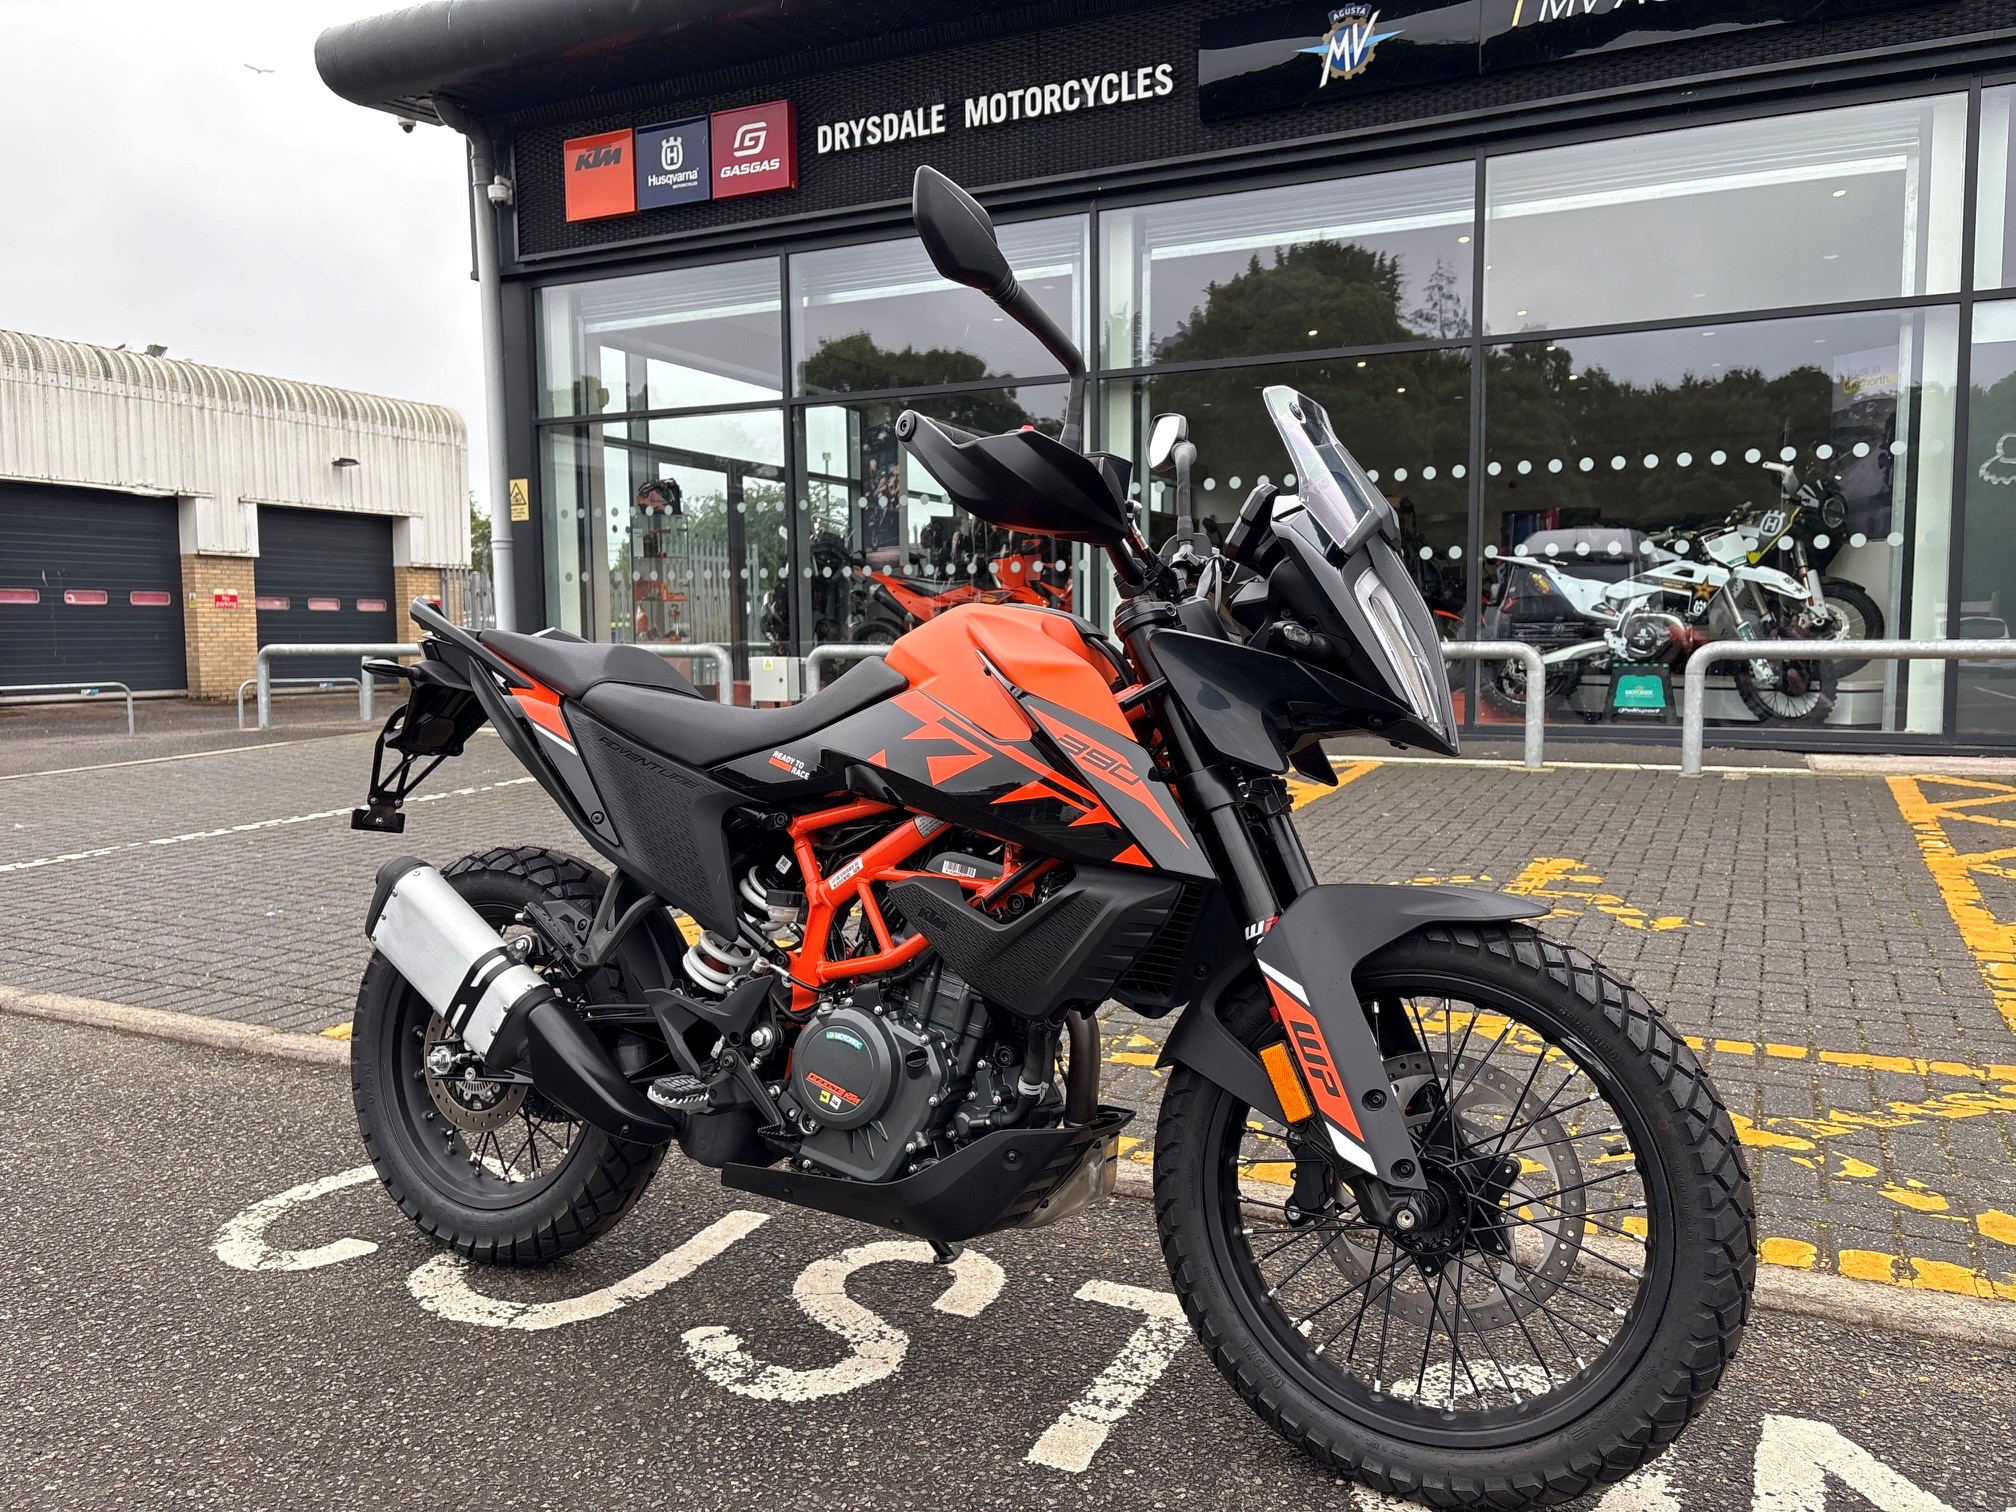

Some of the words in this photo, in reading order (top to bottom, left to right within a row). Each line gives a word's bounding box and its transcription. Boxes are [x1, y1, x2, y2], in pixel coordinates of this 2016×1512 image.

[1333, 6, 1367, 21] AGUSTA
[1319, 8, 1381, 88] MV
[817, 103, 946, 154] DRYSDALE
[964, 63, 1174, 128] MOTORCYCLES
[575, 143, 622, 172] KTM
[720, 157, 781, 178] GASGAS
[648, 168, 699, 188] Husqvarna
[597, 735, 702, 790] ADVENTURE
[772, 750, 796, 766] READY
[795, 759, 805, 769] TO
[1058, 733, 1140, 786] 390
[790, 766, 810, 781] RACE
[835, 1031, 864, 1050] MOTOREX
[1288, 1019, 1342, 1099] WP
